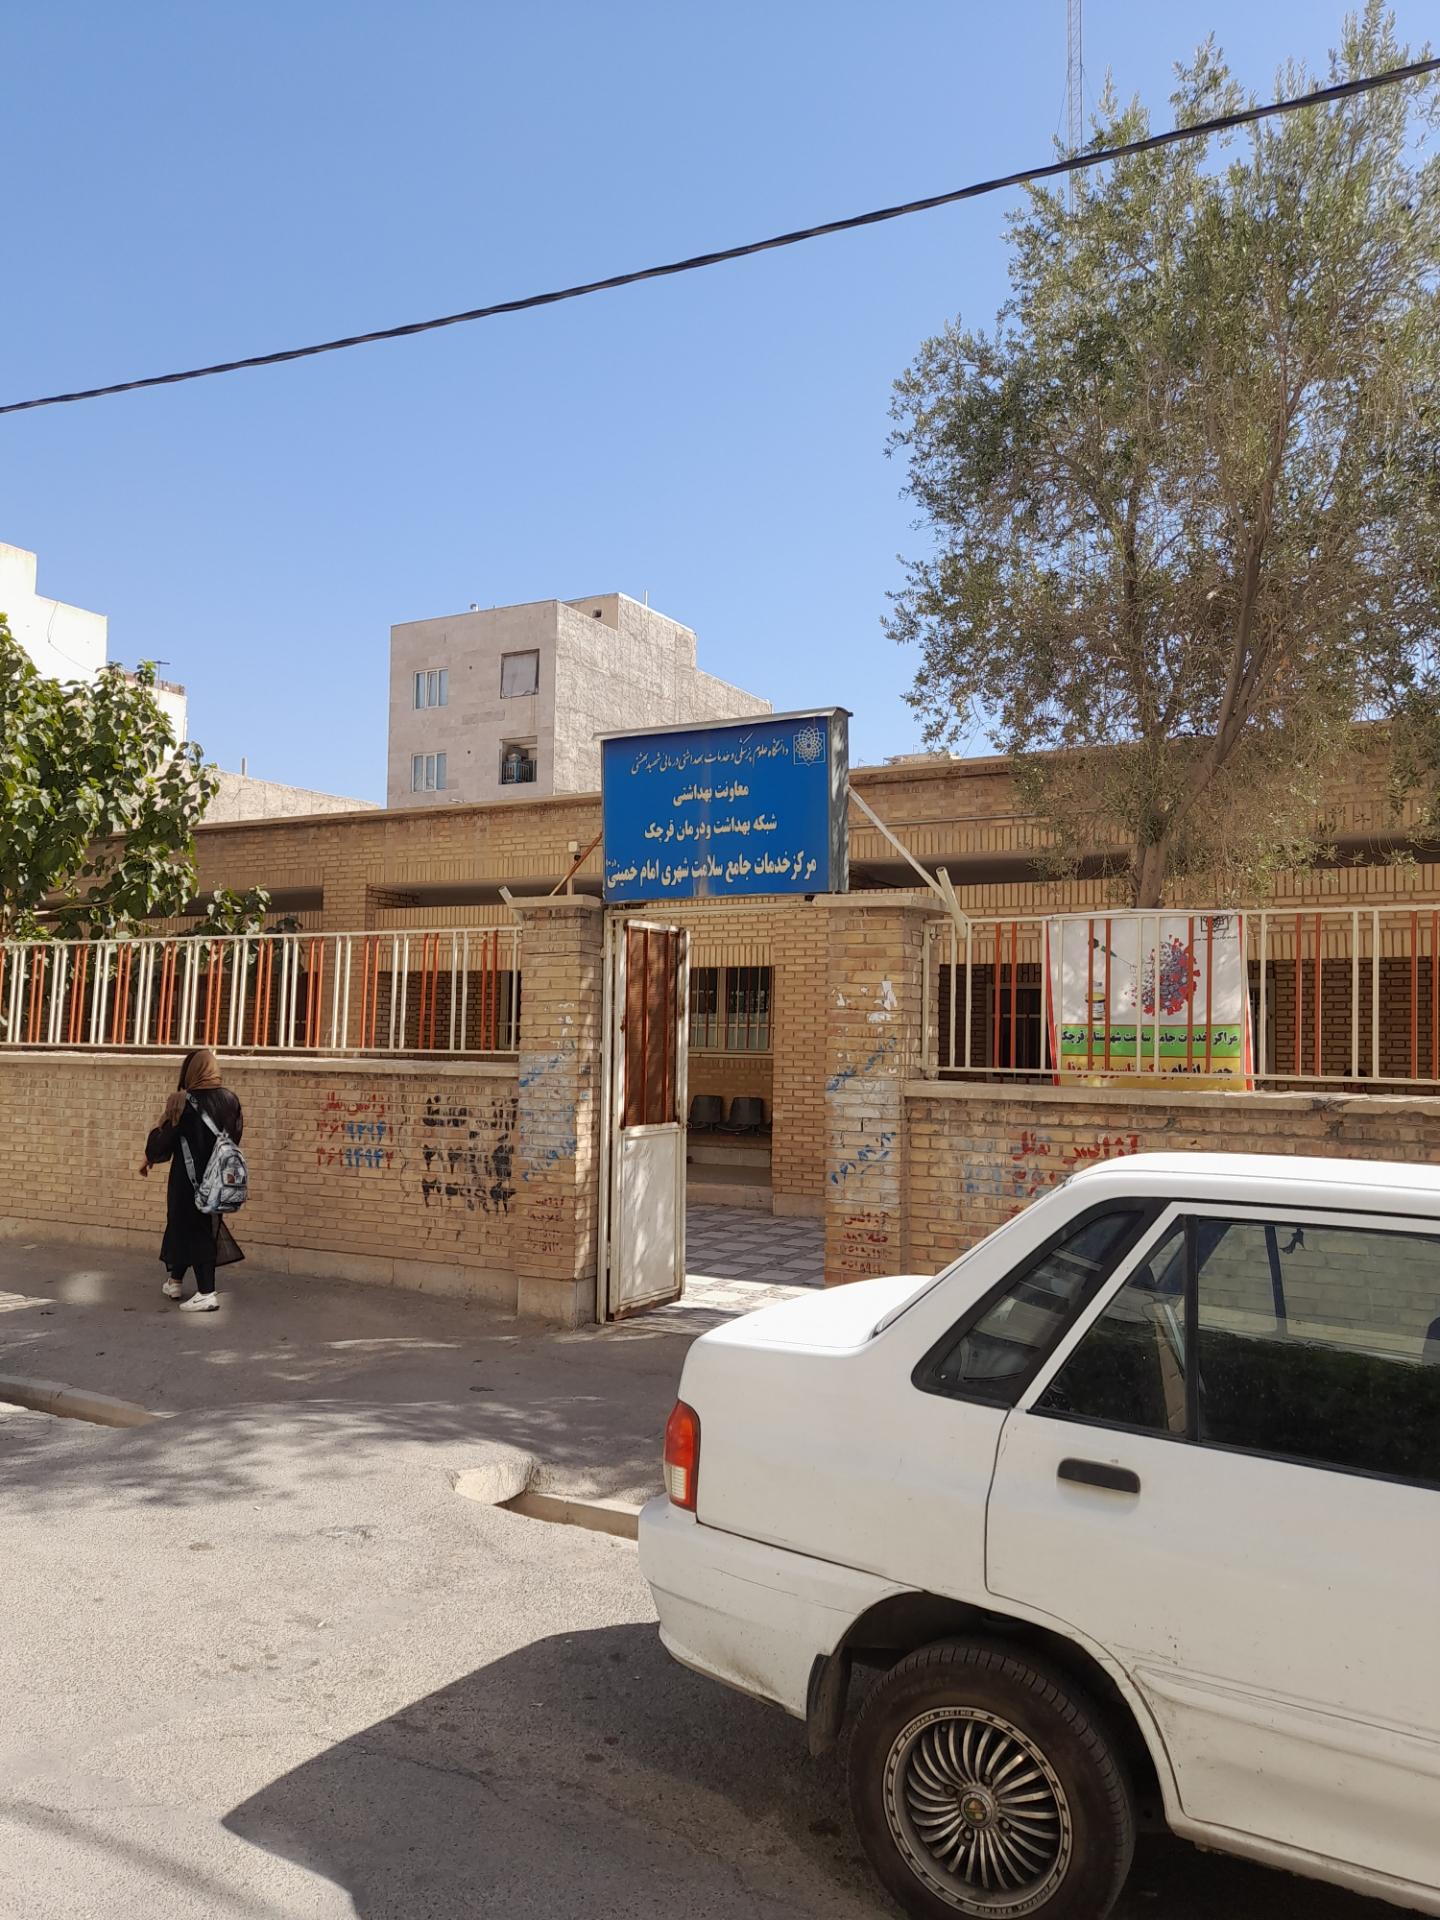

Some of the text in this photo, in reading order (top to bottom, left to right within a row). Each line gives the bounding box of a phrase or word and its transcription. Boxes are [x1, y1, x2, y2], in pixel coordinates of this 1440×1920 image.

[678, 748, 704, 770] بهداشتی
[753, 744, 768, 768] علوم
[767, 737, 789, 758] دانشگاه
[673, 780, 749, 807] معاونت بهداشتی
[644, 819, 675, 843] قرچک
[713, 816, 751, 836] بهداشت
[753, 813, 778, 835] شبکه
[607, 860, 638, 889] خمینی
[640, 857, 660, 887] امام
[661, 857, 689, 886] شهری
[691, 854, 723, 878] سلامت
[725, 852, 751, 883] جامع
[754, 850, 791, 875] خدمات
[790, 850, 817, 880] مرکز
